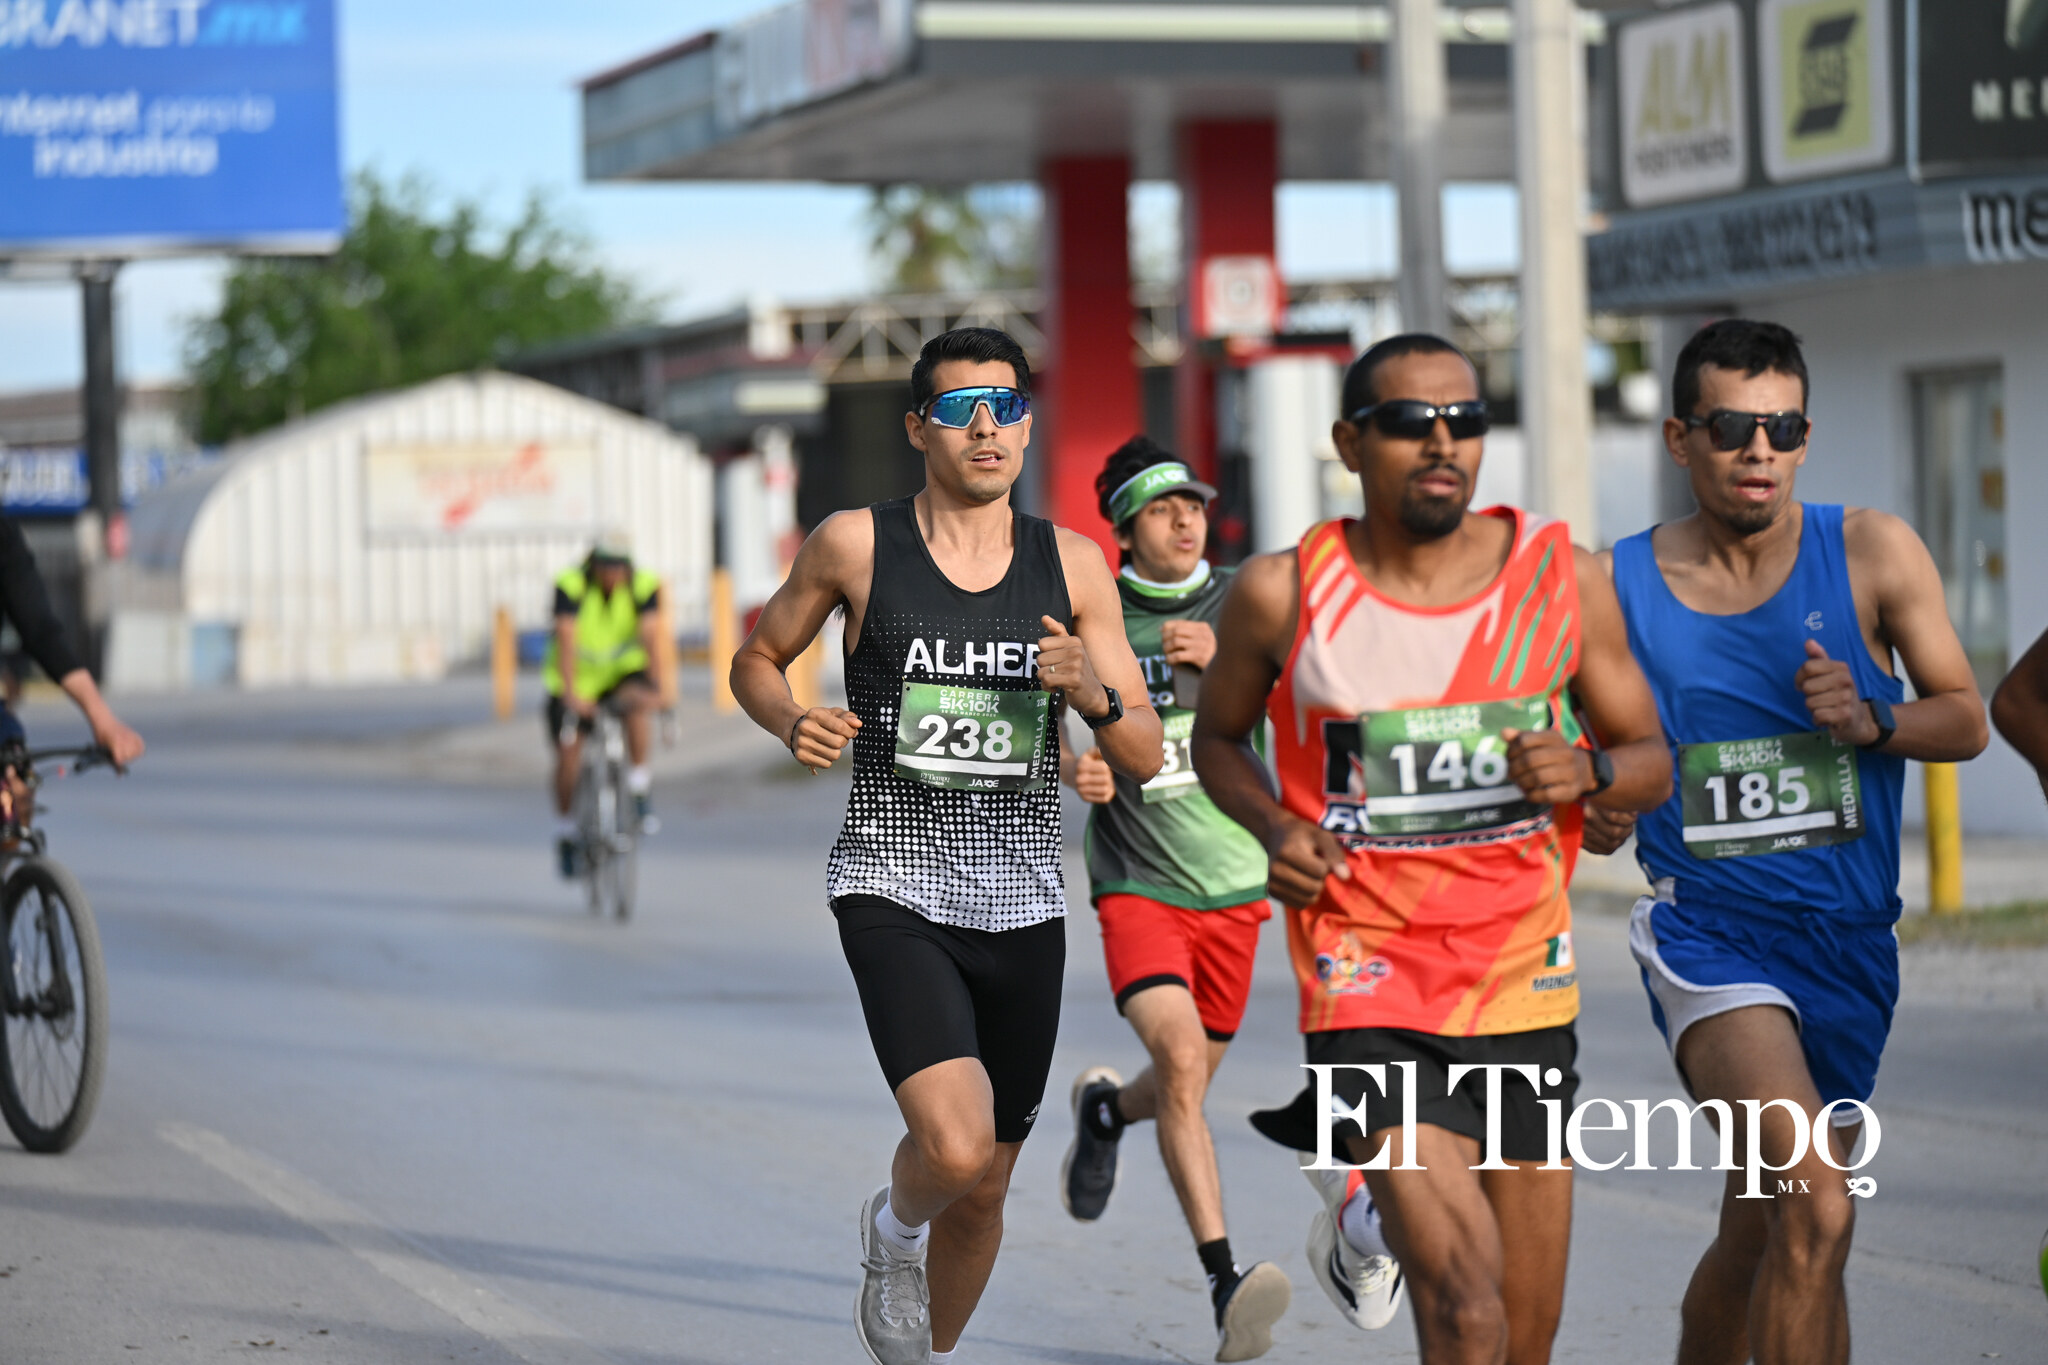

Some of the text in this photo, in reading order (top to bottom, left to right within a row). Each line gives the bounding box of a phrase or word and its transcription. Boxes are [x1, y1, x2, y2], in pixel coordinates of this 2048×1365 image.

[1635, 27, 1731, 138] ALM
[940, 688, 1000, 702] CARRERA
[914, 714, 1013, 760] 238
[1030, 713, 1045, 779] MEDALLA
[1389, 735, 1508, 795] 146
[1718, 738, 1783, 754] CARRERA
[1704, 766, 1810, 821] 185
[1837, 754, 1858, 829] MEDALLA
